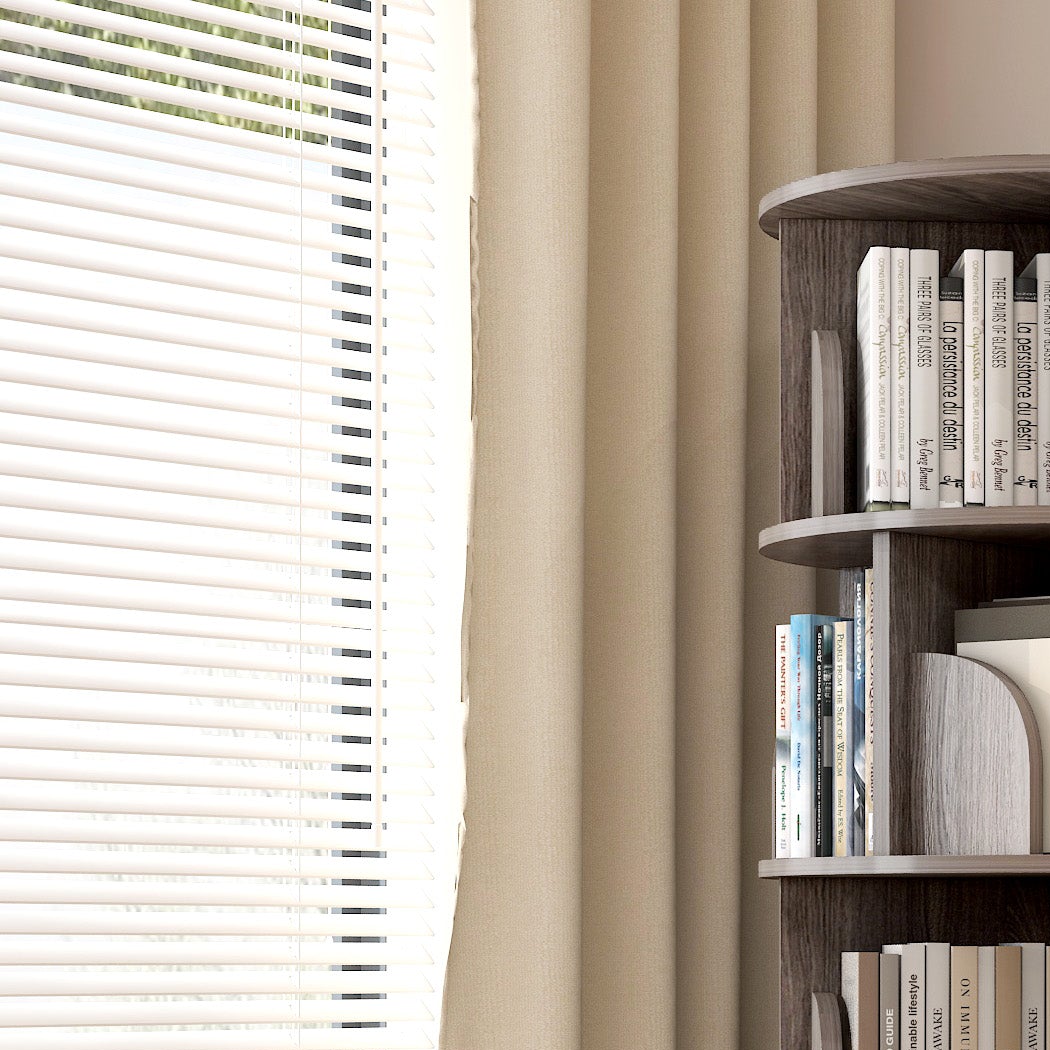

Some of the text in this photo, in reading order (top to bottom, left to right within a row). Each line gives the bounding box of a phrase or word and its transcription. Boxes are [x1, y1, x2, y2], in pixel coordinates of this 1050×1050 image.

[917, 276, 932, 368] THREE PAIRS OF GLASSES
[943, 321, 963, 333] La
[992, 277, 1006, 369] THREE PAIRS OF GLASSES
[1017, 322, 1037, 334] La
[939, 337, 963, 398] persistance
[1013, 337, 1037, 399] persistance
[943, 401, 963, 415] du
[1017, 402, 1037, 415] du
[943, 419, 963, 451] destin
[1017, 419, 1037, 451] destin
[918, 438, 933, 491] by Greg Bennet
[992, 439, 1008, 491] by Greg Bennet
[908, 974, 920, 1016] lifestyle
[960, 978, 970, 997] ON
[886, 1009, 894, 1045] GUIDE
[932, 1007, 942, 1050] AWAKE
[1027, 1007, 1037, 1050] AWAKE
